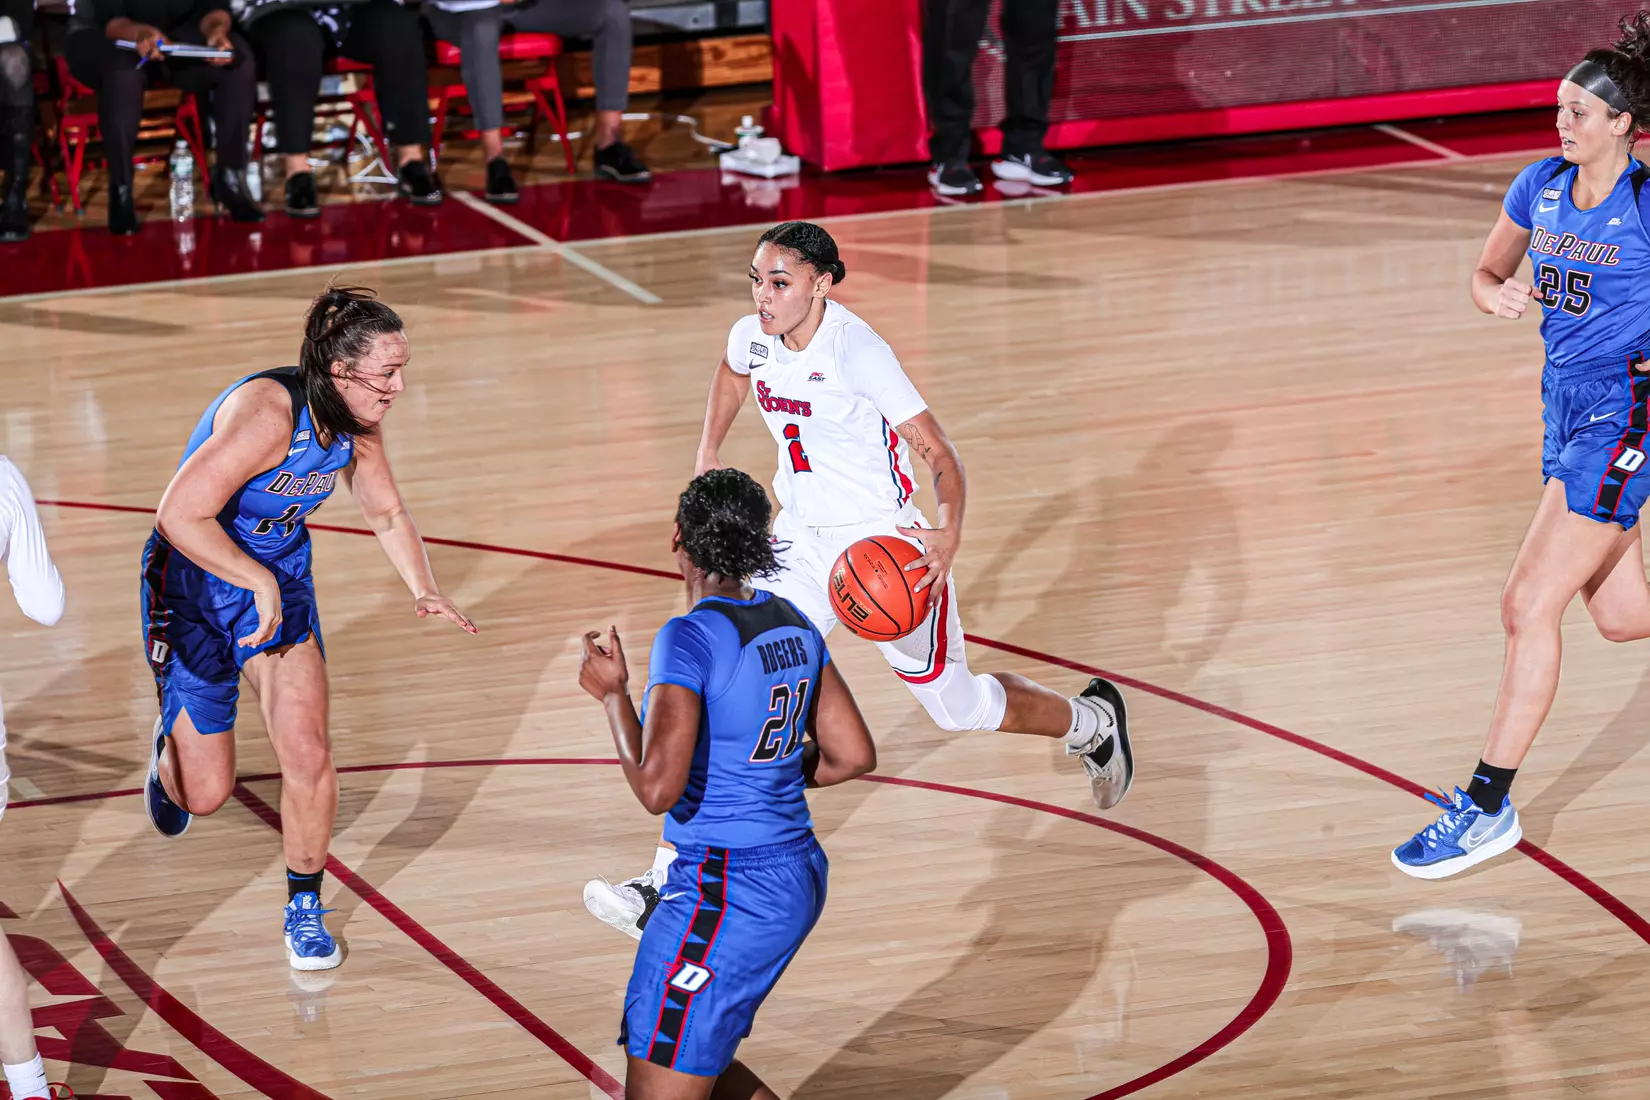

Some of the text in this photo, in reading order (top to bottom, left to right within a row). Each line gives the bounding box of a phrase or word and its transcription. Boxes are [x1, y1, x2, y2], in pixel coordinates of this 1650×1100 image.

[1055, 0, 1148, 27] AIN
[1539, 263, 1594, 318] 25
[783, 423, 812, 474] 2
[1612, 444, 1649, 474] D
[832, 570, 870, 624] ELITE
[151, 639, 170, 664] D
[757, 636, 808, 675] ROGERS
[749, 678, 810, 762] 21
[666, 960, 713, 993] D
